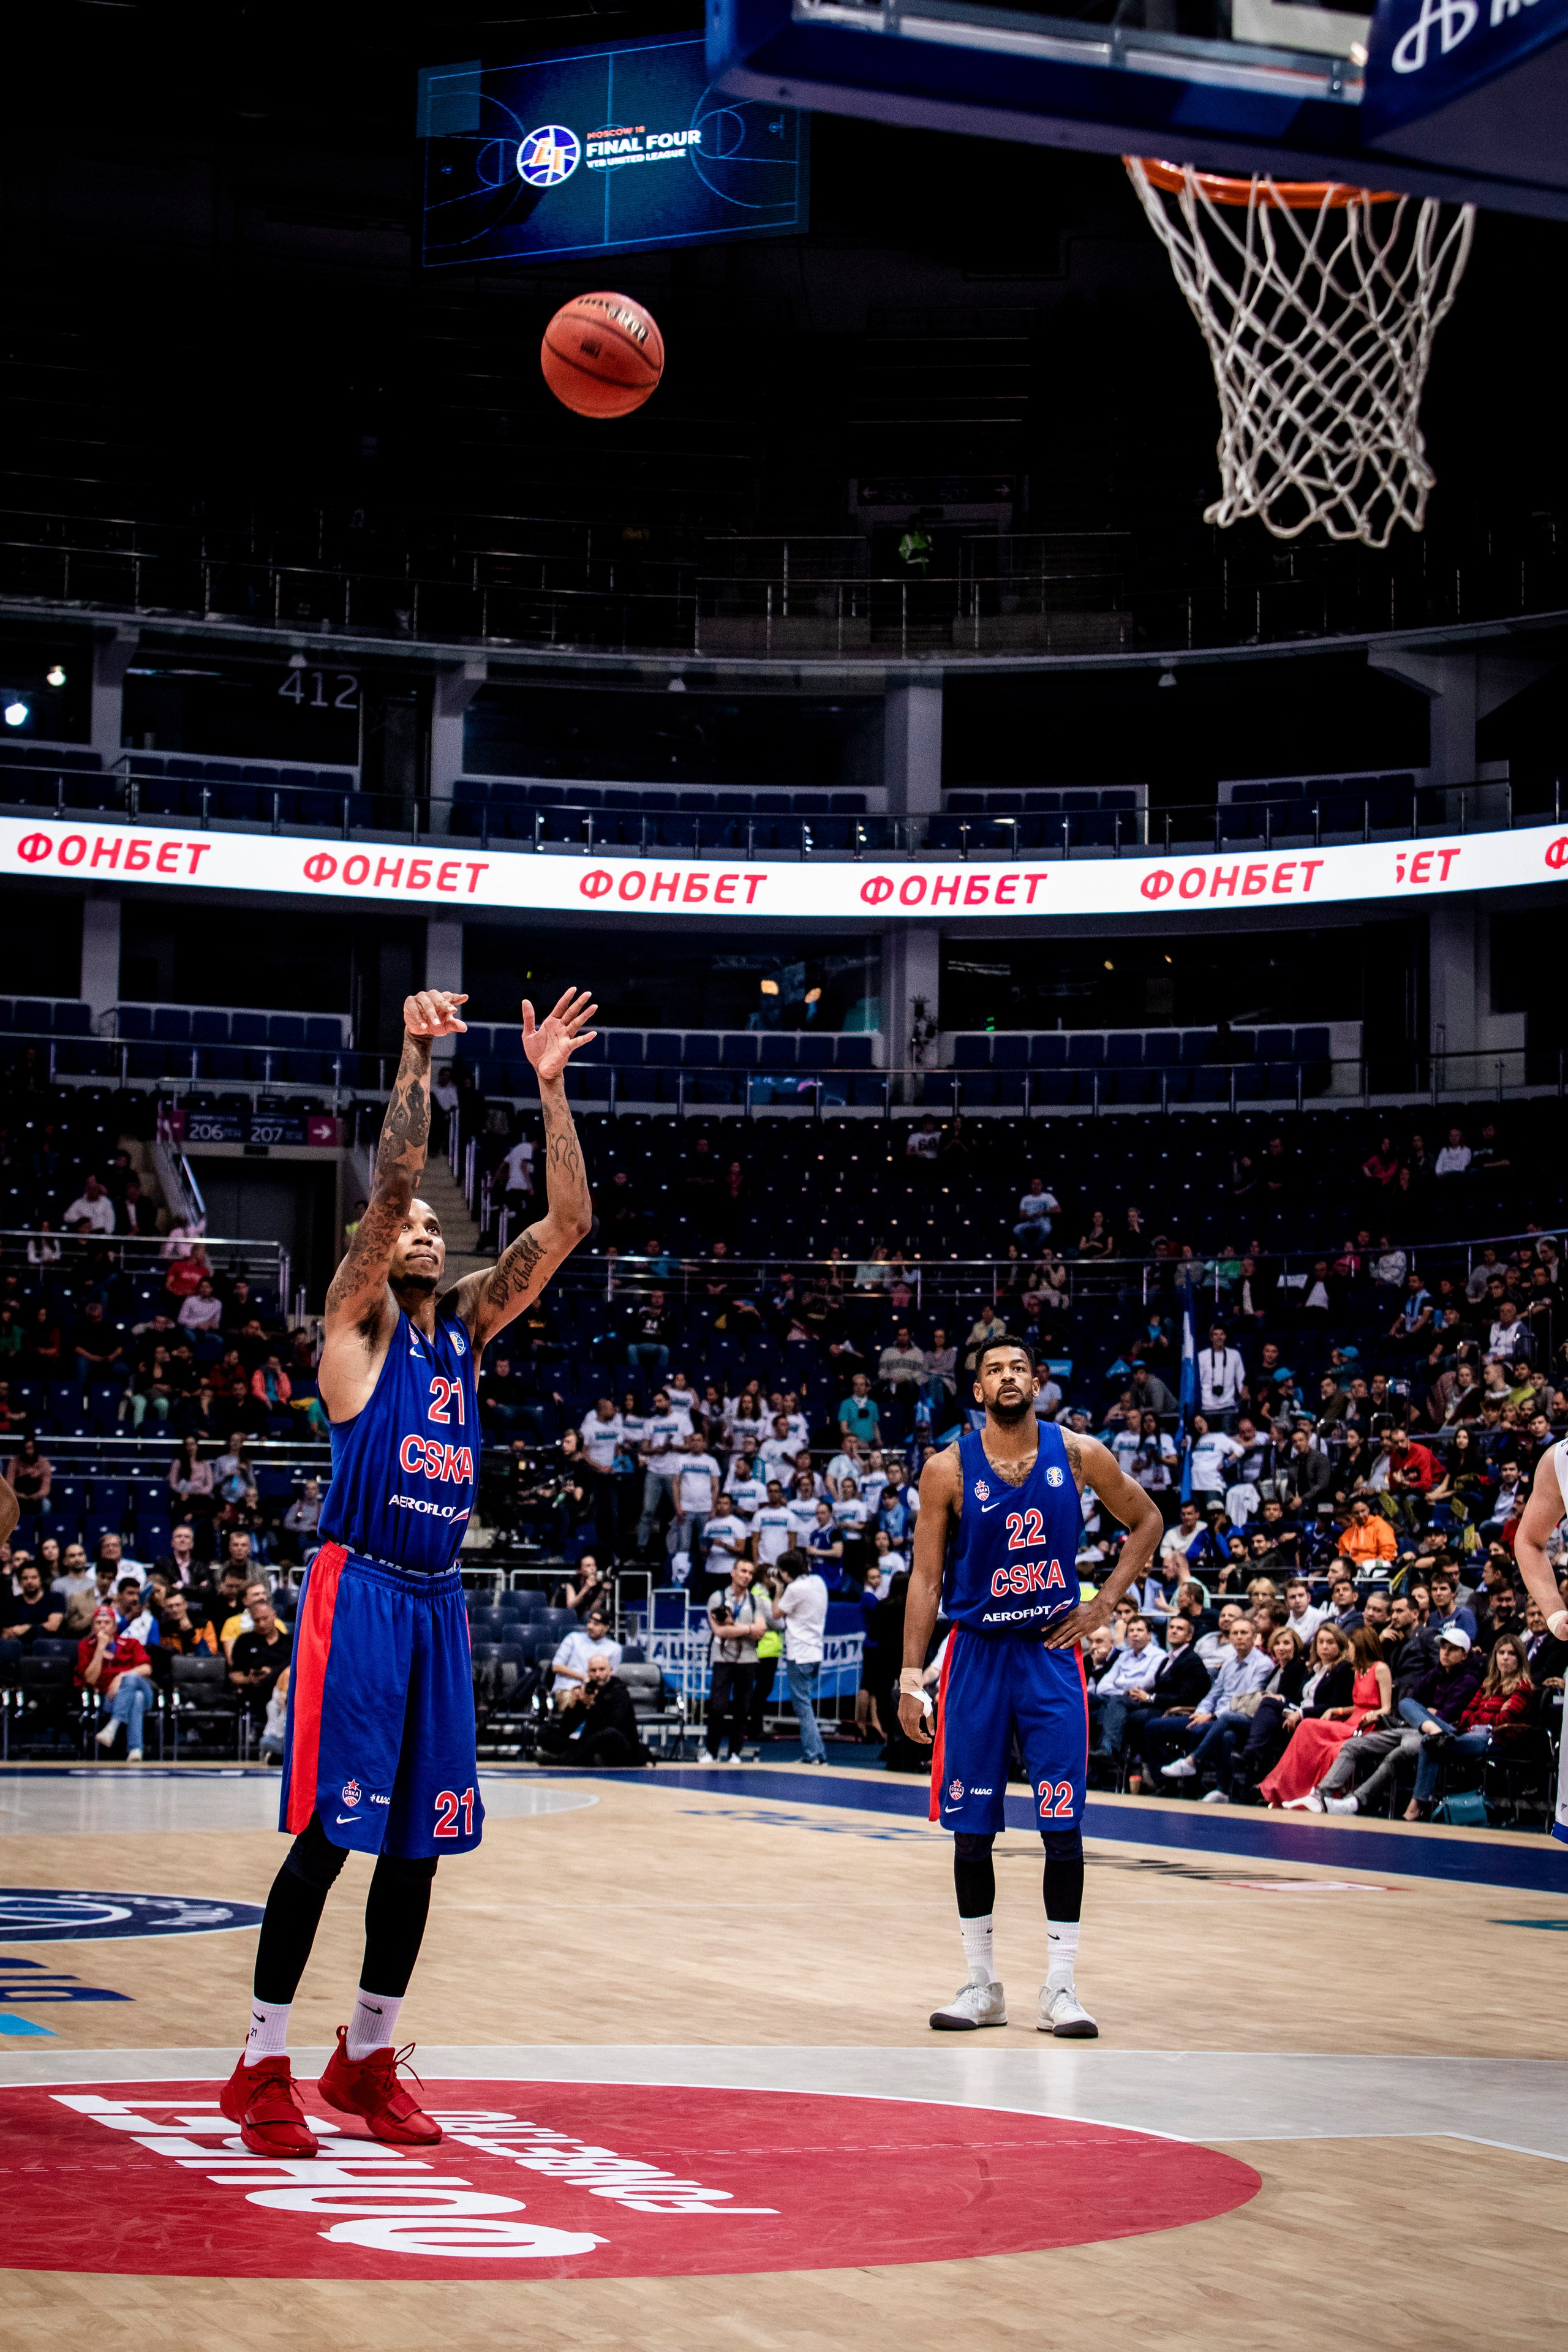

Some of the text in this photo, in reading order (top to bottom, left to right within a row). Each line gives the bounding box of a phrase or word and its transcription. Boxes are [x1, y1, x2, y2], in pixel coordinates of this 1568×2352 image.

[586, 129, 702, 157] FINAL FOUR
[587, 127, 633, 140] MOSCOW
[586, 148, 687, 168] VTB UNITED LEAGUE
[278, 670, 358, 709] 412
[17, 833, 211, 874] ФОНБЕТ
[304, 853, 489, 892] ФОНБЕТ
[580, 870, 767, 903] ФОНБЕТ
[860, 873, 1047, 905] ФОНБЕТ
[1140, 861, 1324, 900] ФОНБЕТ
[189, 1123, 224, 1141] 206
[250, 1126, 283, 1142] 207
[428, 1376, 465, 1425] 21
[399, 1434, 473, 1485] CSKA
[1006, 1508, 1046, 1550] 22
[991, 1559, 1066, 1597] CSKA
[375, 1795, 391, 1805] UAC
[433, 1787, 474, 1837] 21
[1038, 1781, 1074, 1818] 22
[251, 2027, 257, 2038] 21
[421, 2110, 781, 2215] FONBET.RU
